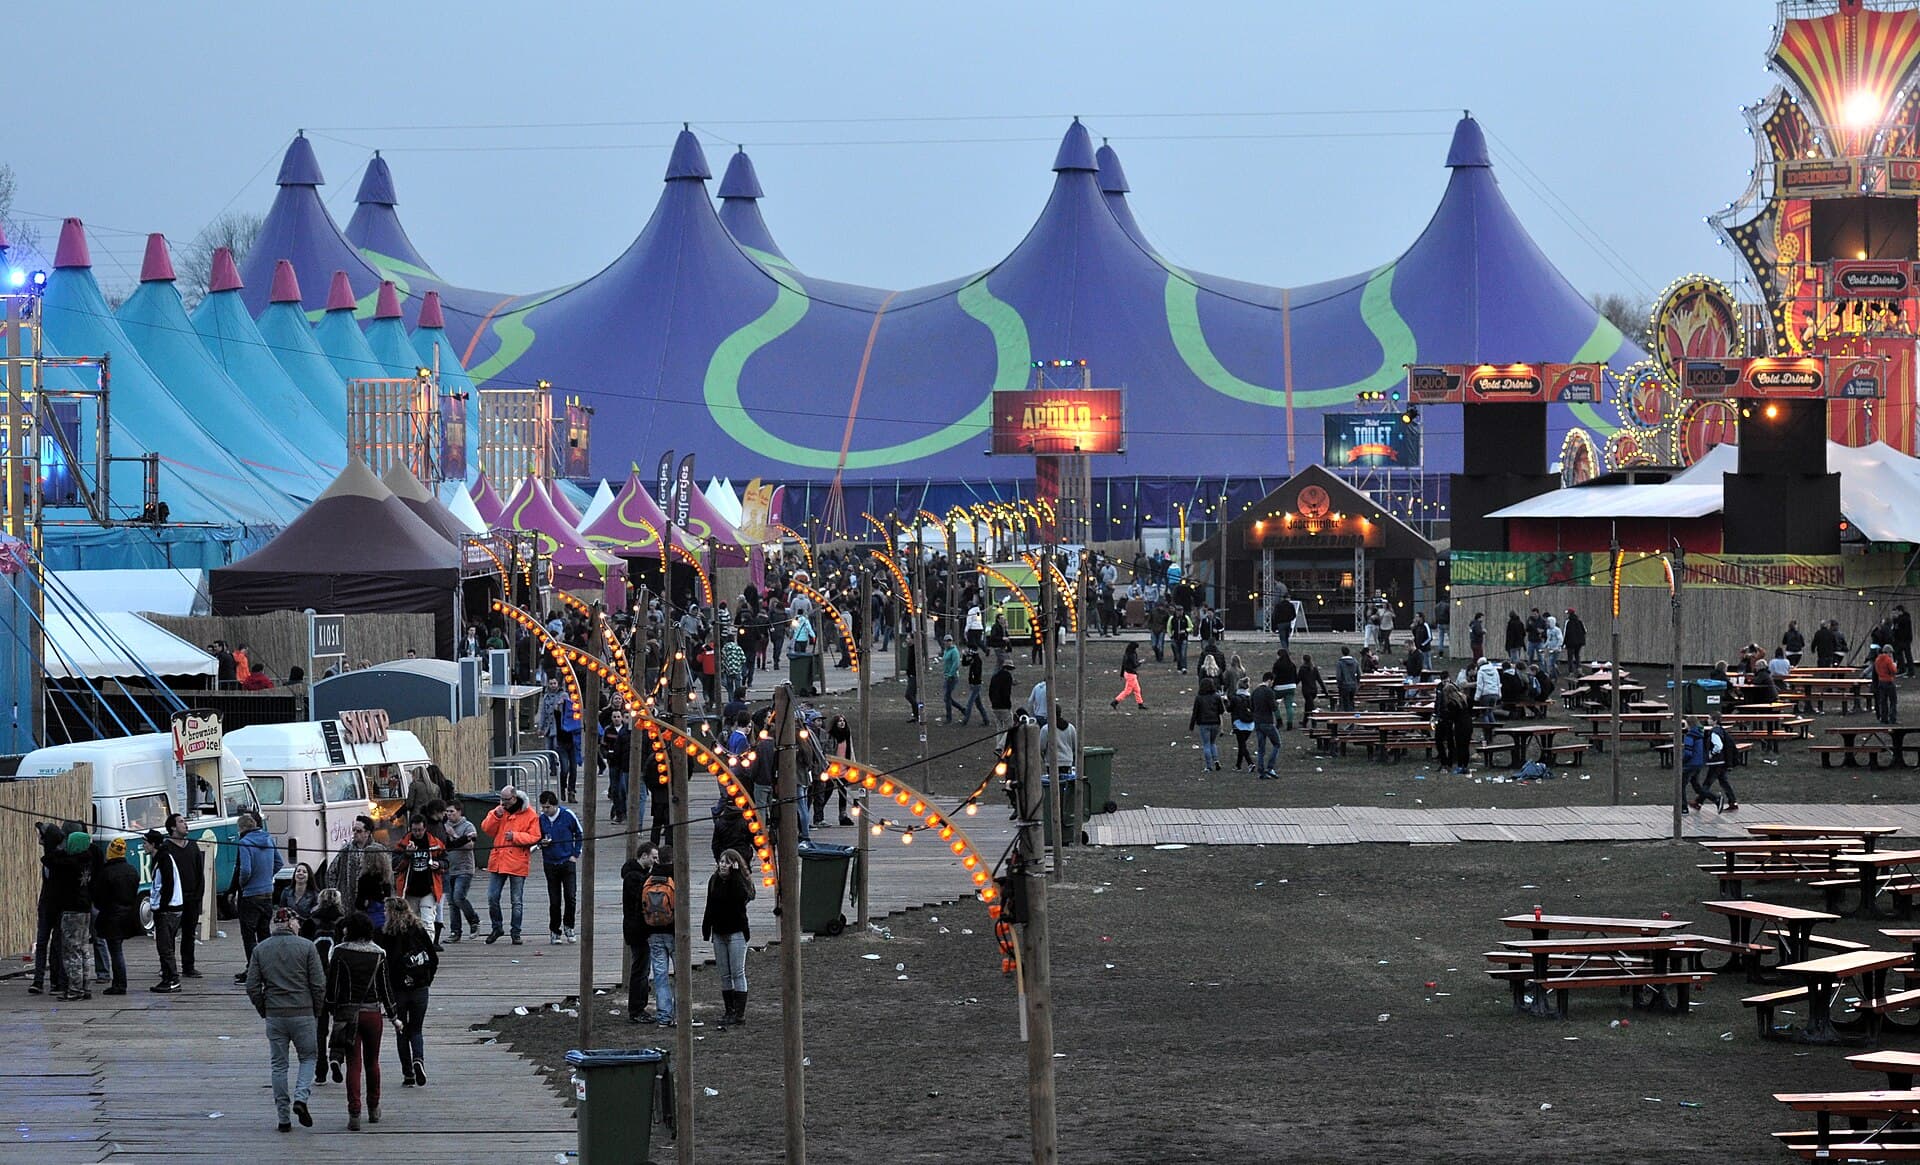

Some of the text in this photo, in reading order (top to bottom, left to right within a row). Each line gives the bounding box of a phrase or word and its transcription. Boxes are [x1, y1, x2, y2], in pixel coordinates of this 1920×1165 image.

[1787, 169, 1849, 185] DRINKS
[1847, 274, 1900, 285] Cold Drinks
[1568, 367, 1588, 382] Cool
[1688, 369, 1726, 385] LIQUOR
[1757, 372, 1815, 384] Cold Drinks
[1852, 364, 1873, 378] Cool
[1479, 378, 1533, 390] Cold Drinks
[1022, 406, 1091, 430] APOLLO
[1353, 426, 1392, 446] TOILET
[658, 463, 668, 513] ffertjes
[1763, 565, 1845, 586] SOUNDSYSTEM
[318, 624, 340, 646] KIOSK
[187, 726, 218, 741] brownies
[338, 708, 390, 745] SNOEP
[206, 737, 221, 751] ice!
